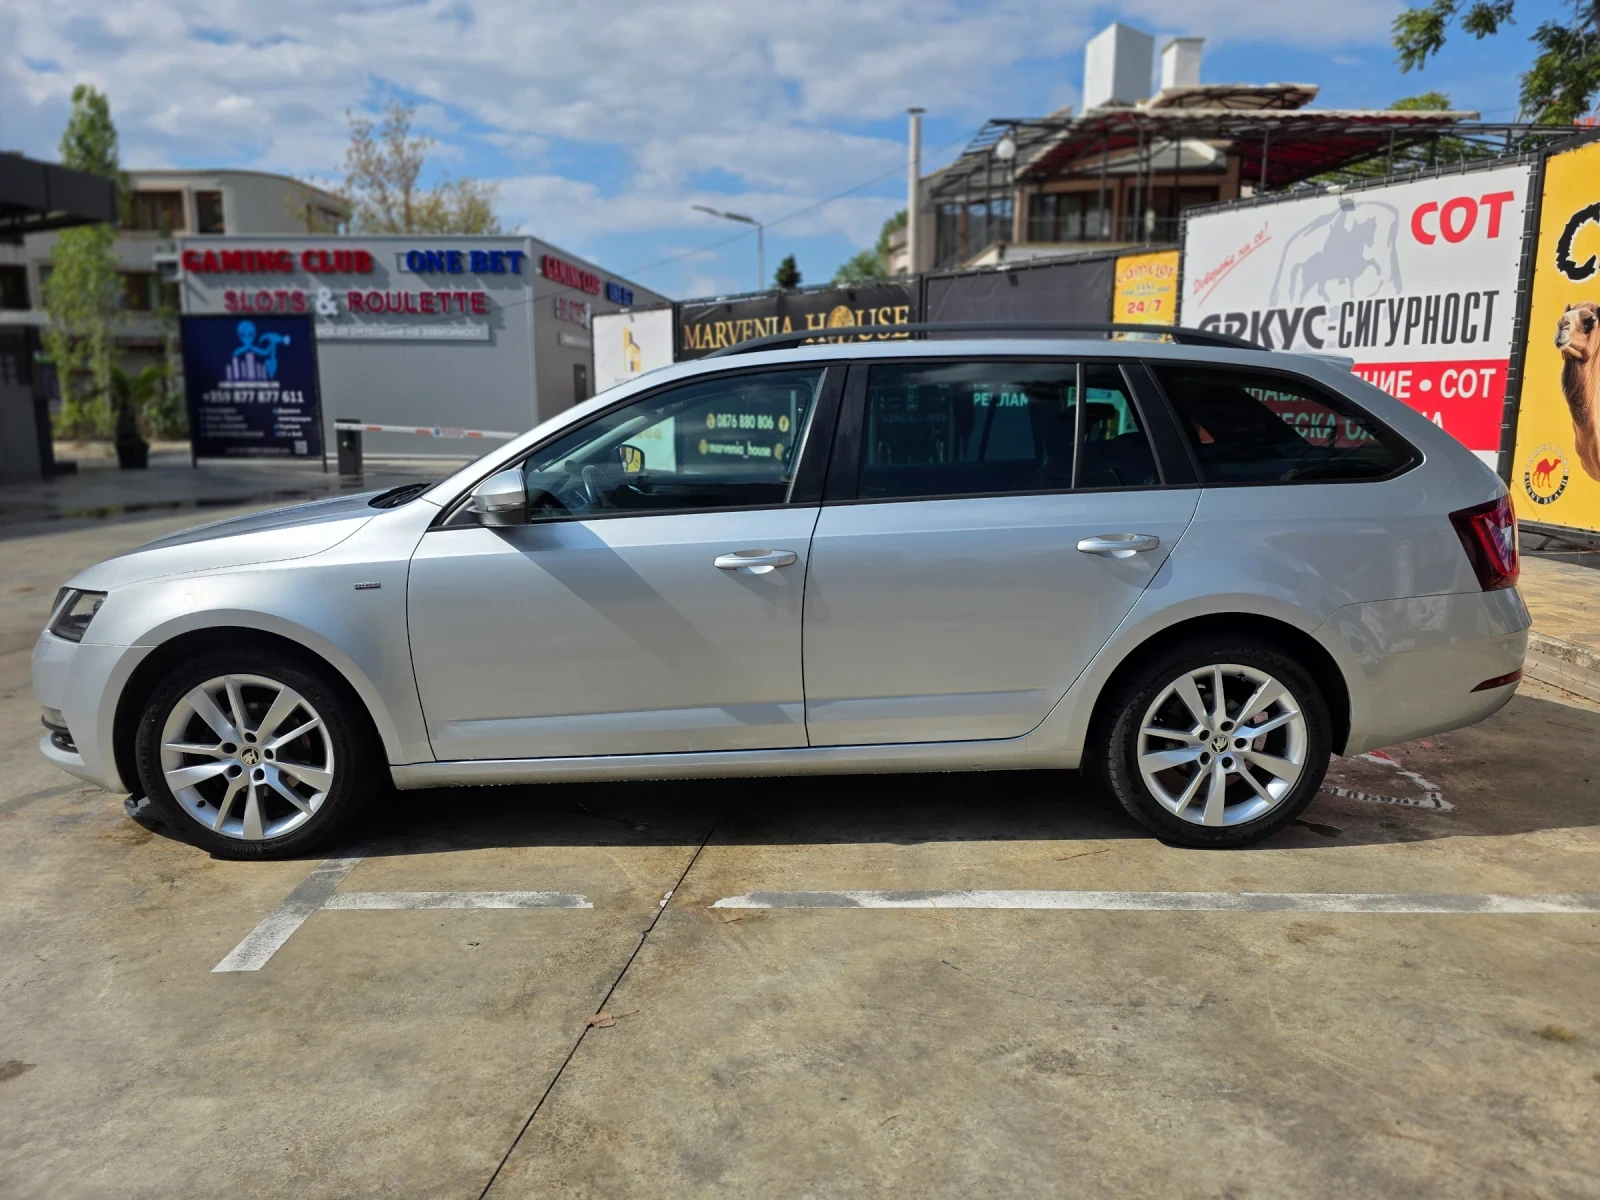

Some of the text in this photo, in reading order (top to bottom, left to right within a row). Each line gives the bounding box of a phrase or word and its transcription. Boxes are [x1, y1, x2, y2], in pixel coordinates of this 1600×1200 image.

[1411, 191, 1515, 245] СОТ
[182, 250, 373, 274] GAMING CLUB
[406, 250, 524, 274] ONE BET
[224, 287, 488, 315] SLOTS & ROULETTE
[1127, 299, 1162, 315] 24/7
[684, 315, 793, 350] MARVENIA
[1440, 368, 1497, 398] СОТ
[233, 390, 255, 403] 877
[257, 390, 279, 403] 877
[281, 390, 304, 403] 611
[717, 413, 774, 429] 0876 880 806
[709, 440, 772, 459] marvenia_house
[1525, 474, 1568, 504] SUNNY BEACH
